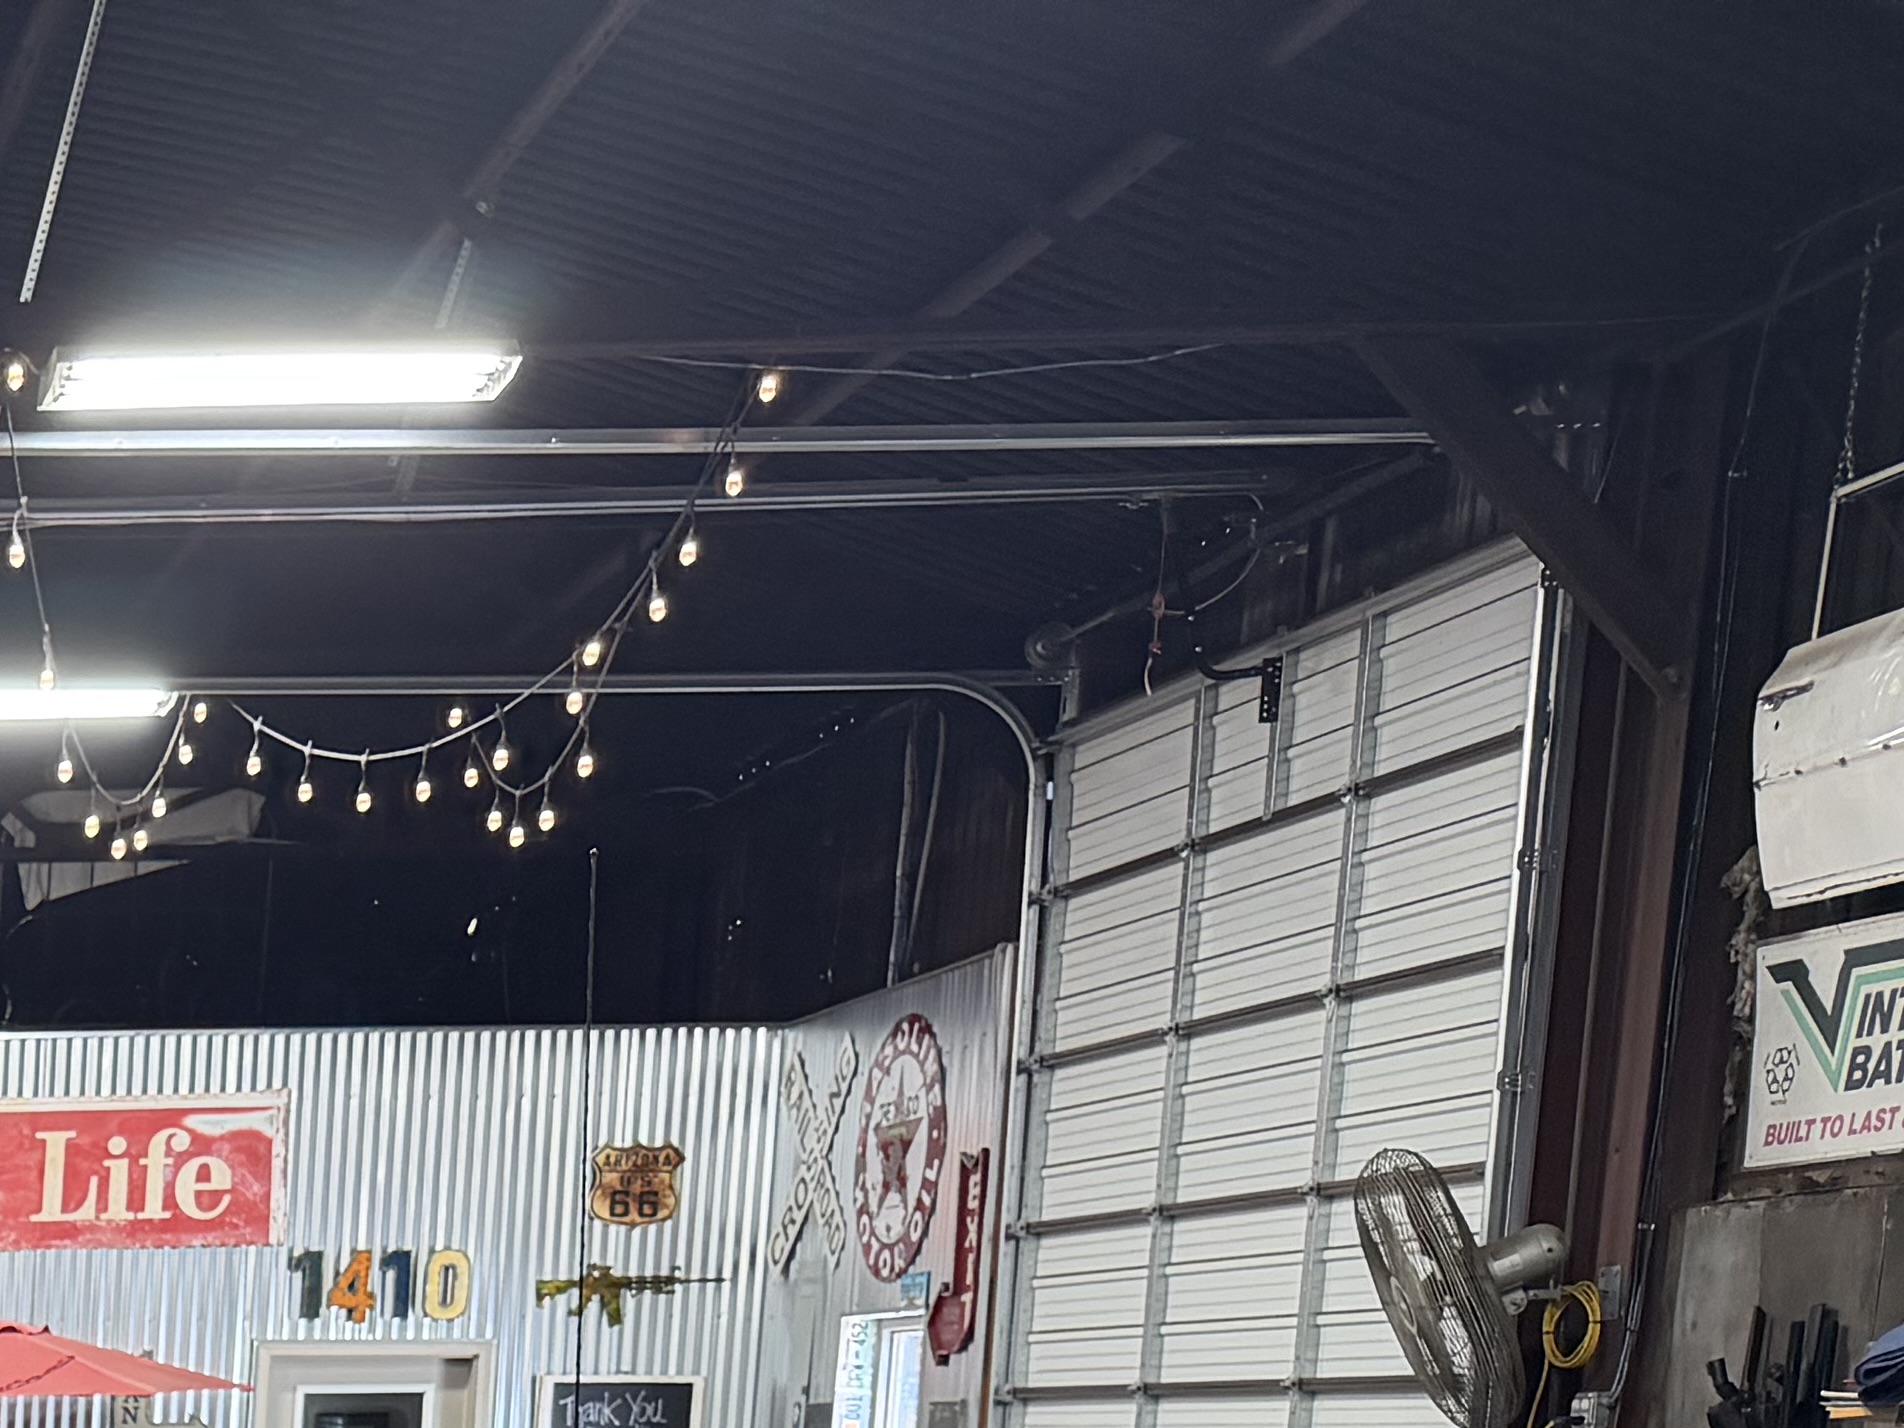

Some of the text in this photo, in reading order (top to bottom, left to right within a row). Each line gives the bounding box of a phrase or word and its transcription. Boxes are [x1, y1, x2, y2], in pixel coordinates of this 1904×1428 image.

[1763, 1105, 1901, 1147] BUILT TO LAST
[28, 1127, 232, 1224] Life
[601, 1151, 673, 1167] ARIZONA
[609, 1190, 659, 1218] 66
[909, 1159, 940, 1244] OIL
[287, 1248, 472, 1324] 1410
[625, 1390, 667, 1426] You
